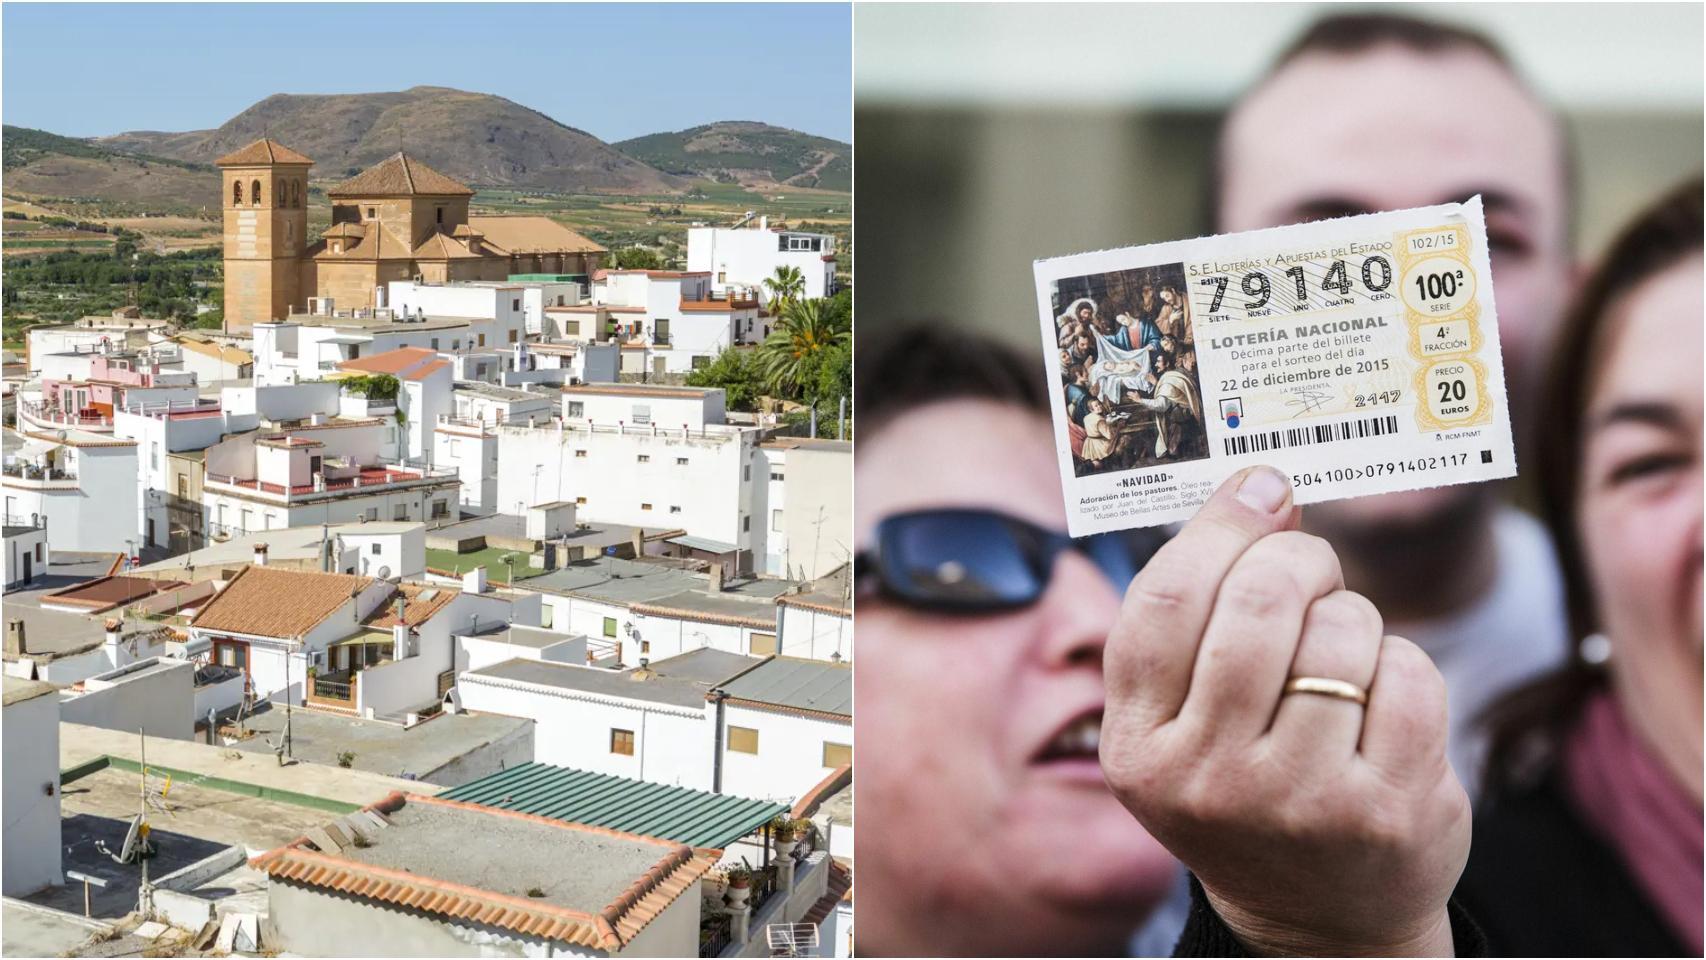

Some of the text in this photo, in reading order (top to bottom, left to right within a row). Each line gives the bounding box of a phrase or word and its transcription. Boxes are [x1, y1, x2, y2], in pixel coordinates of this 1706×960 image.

[1412, 235, 1454, 249] 102/15
[1209, 292, 1391, 323] SIETE NUEVE UNO CUATRO CERO
[1430, 302, 1451, 312] SERIE
[1211, 316, 1388, 350] LOTERÍA NACIONAL
[1231, 334, 1372, 360] Décima parte del billete
[1425, 339, 1467, 352] FRACCIÓN
[1241, 347, 1365, 373] para el sorteo del día
[1221, 358, 1389, 392] 22 de diciembre de 2015
[1435, 366, 1464, 376] PRECIO
[1437, 379, 1466, 403] 20
[1441, 405, 1470, 415] EUROS
[1288, 452, 1467, 488] 504100>0791402117
[1116, 472, 1174, 488] «NAVIDAD»
[1079, 493, 1119, 505] Adoración
[1120, 490, 1130, 499] de
[1131, 488, 1143, 497] los
[1102, 502, 1113, 511] por
[1136, 497, 1148, 506] del
[1093, 511, 1119, 520] Museo
[1119, 508, 1129, 517] de
[1171, 501, 1181, 510] de
